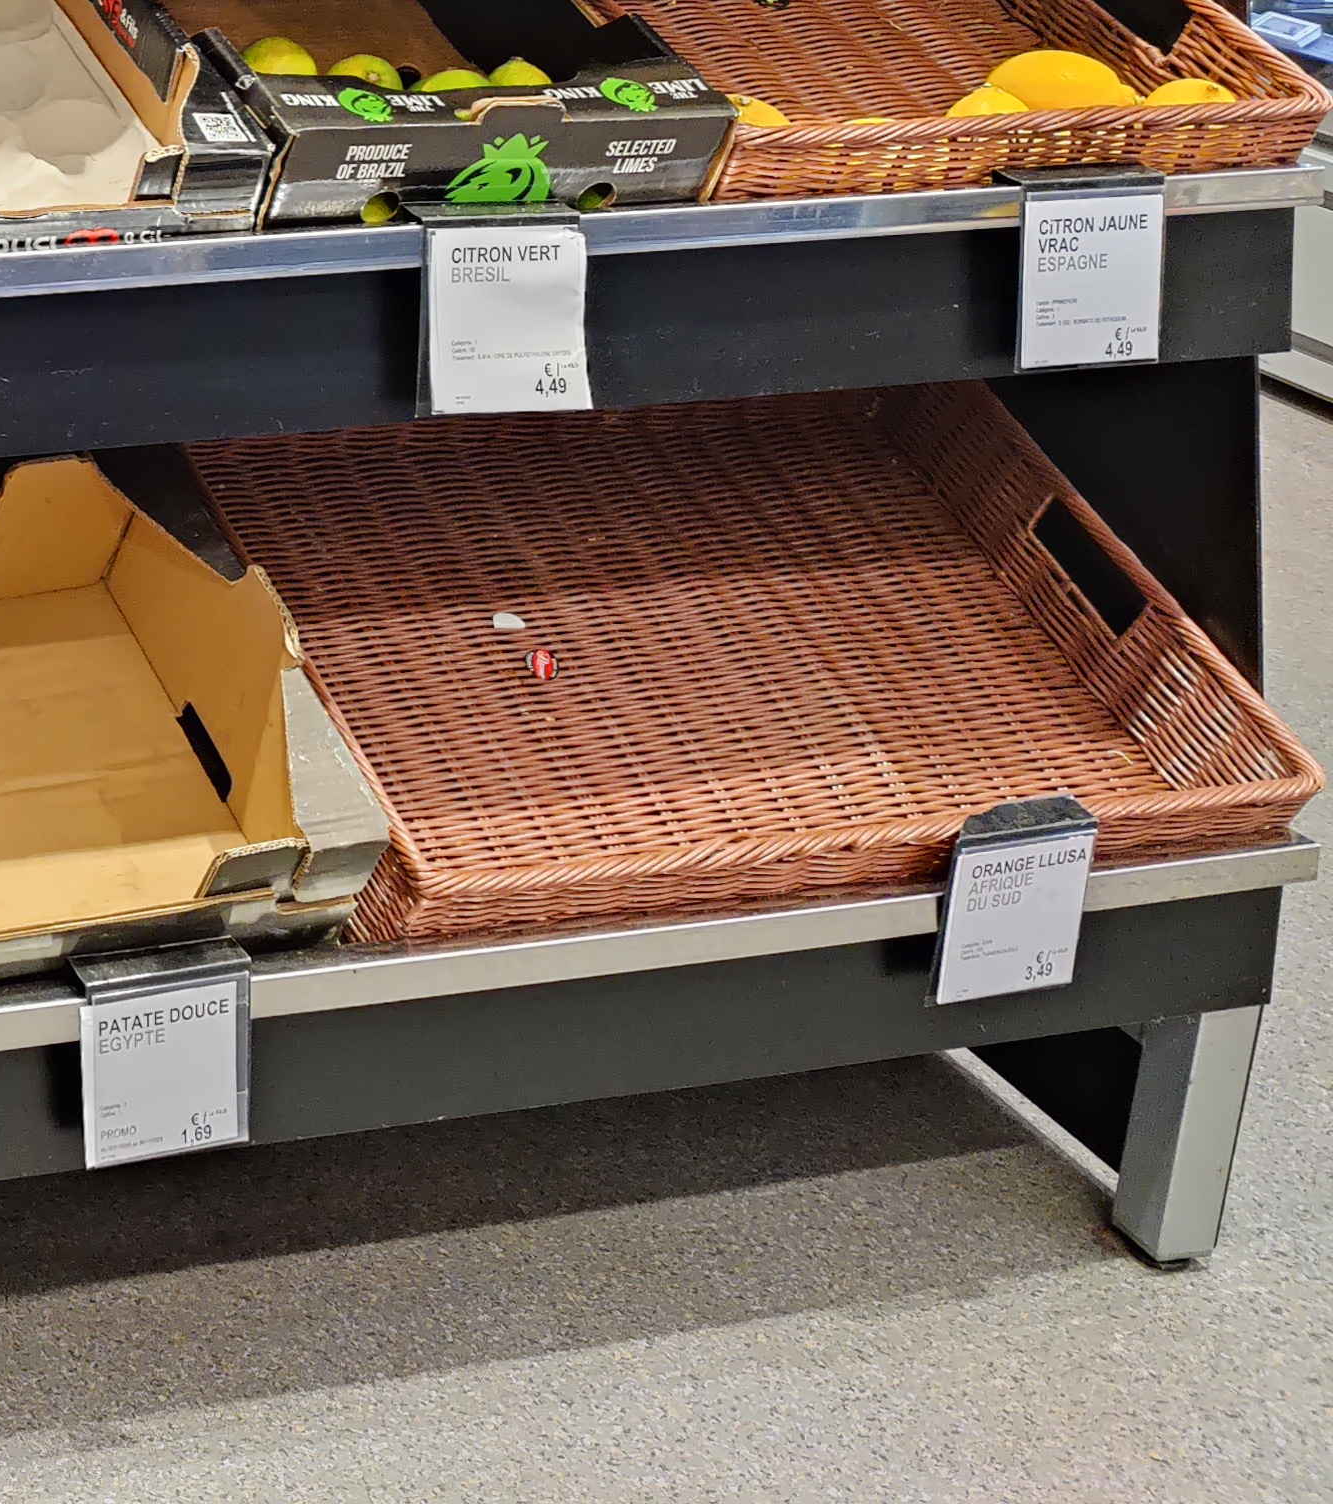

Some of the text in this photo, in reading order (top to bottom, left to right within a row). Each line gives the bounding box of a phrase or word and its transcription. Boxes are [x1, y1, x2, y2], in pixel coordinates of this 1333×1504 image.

[649, 77, 707, 95] LIME
[279, 93, 447, 109] LIME KING
[345, 144, 413, 162] PRODUCE
[605, 138, 677, 157] SELECTED
[336, 161, 407, 179] OF BRAZIL
[612, 157, 658, 174] LIMES
[1039, 214, 1148, 236] CITRON JAUNE
[452, 245, 561, 264] CITRON VERT
[1038, 237, 1079, 254] VRAC
[1037, 254, 1108, 273] ESPAGNE
[451, 266, 511, 283] BRESIL
[1105, 341, 1133, 360] 4,49
[535, 378, 567, 397] 4,49
[971, 848, 1087, 879] ORANGE LLUSA
[968, 872, 1034, 896] AFRIQUE
[966, 891, 1023, 912] DU SUD
[1024, 962, 1053, 982] 3,49
[99, 998, 230, 1036] PATATE DOUCE
[99, 1028, 166, 1054] EGYPTE
[100, 1125, 138, 1141] PROMO
[181, 1124, 212, 1144] 1,69
